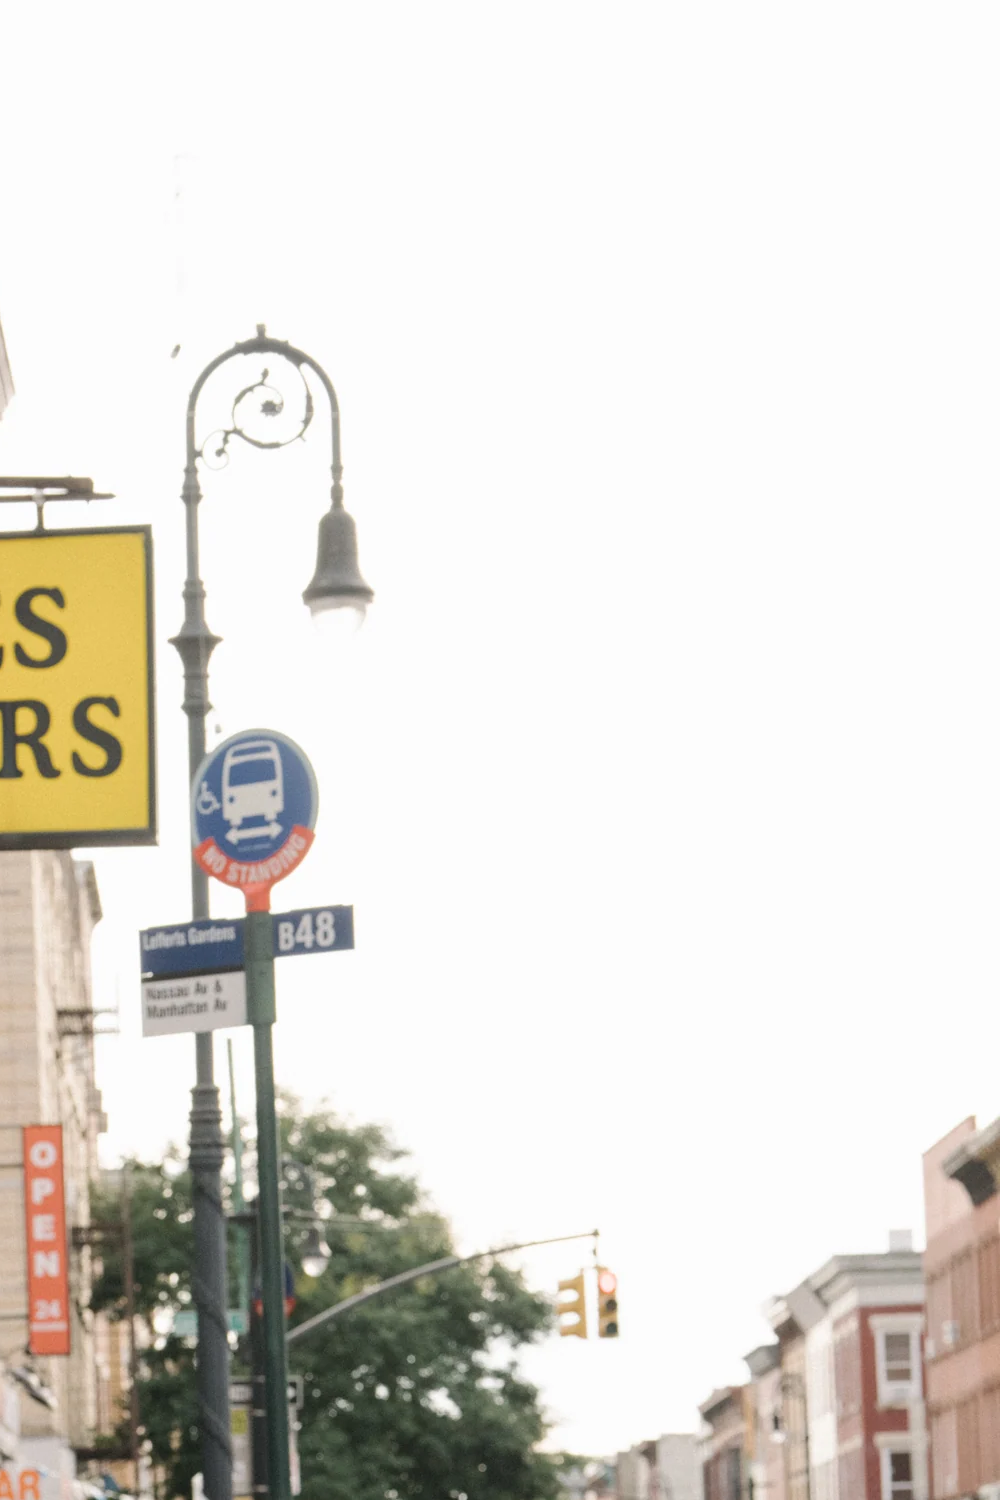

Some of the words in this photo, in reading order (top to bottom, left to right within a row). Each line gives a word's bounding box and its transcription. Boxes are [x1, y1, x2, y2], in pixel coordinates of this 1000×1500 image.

[202, 845, 227, 874] NO
[226, 833, 306, 884] STANDING
[188, 926, 236, 945] Gardens
[278, 911, 336, 951] B48
[146, 985, 188, 1000] Nassau
[147, 1002, 208, 1018] Manhattan
[29, 1141, 60, 1278] OPEN
